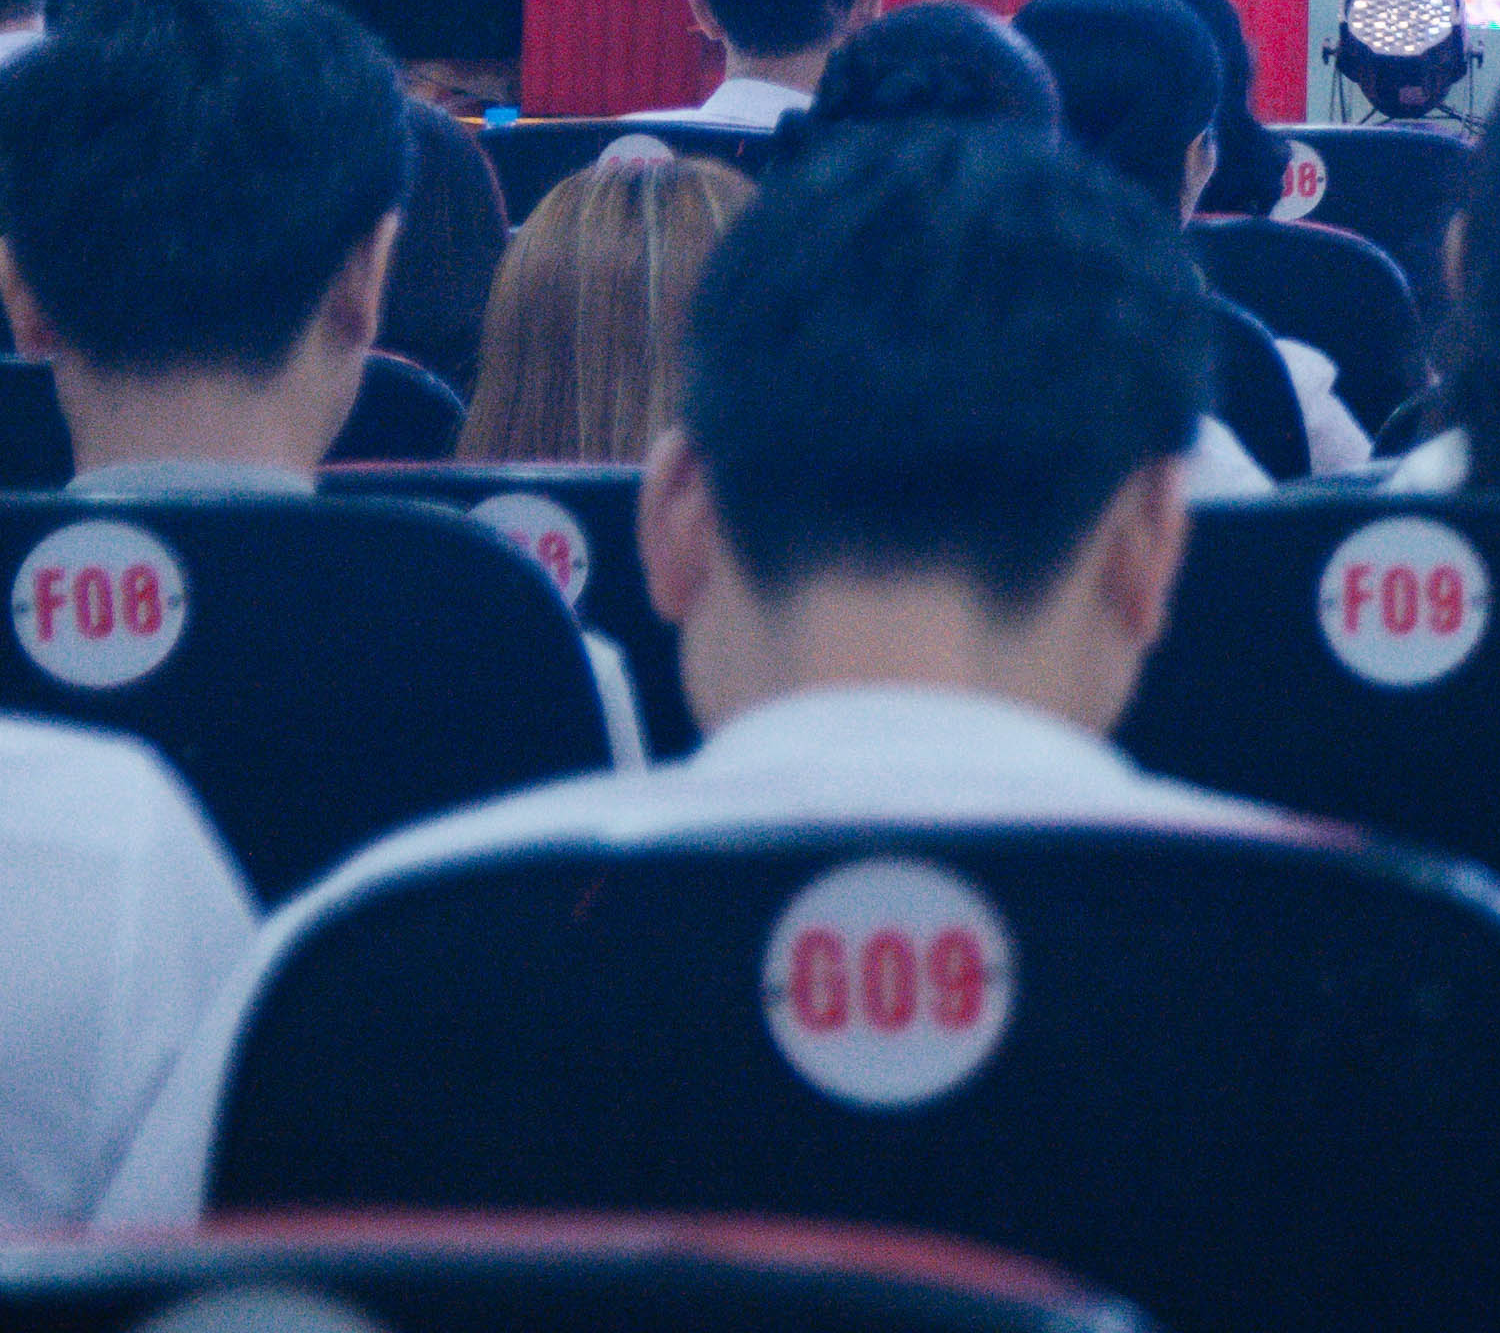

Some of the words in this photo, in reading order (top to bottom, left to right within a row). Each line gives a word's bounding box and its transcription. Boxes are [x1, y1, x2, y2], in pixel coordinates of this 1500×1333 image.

[33, 566, 164, 642] F08
[1343, 562, 1464, 636] F09
[786, 926, 986, 1034] G09
